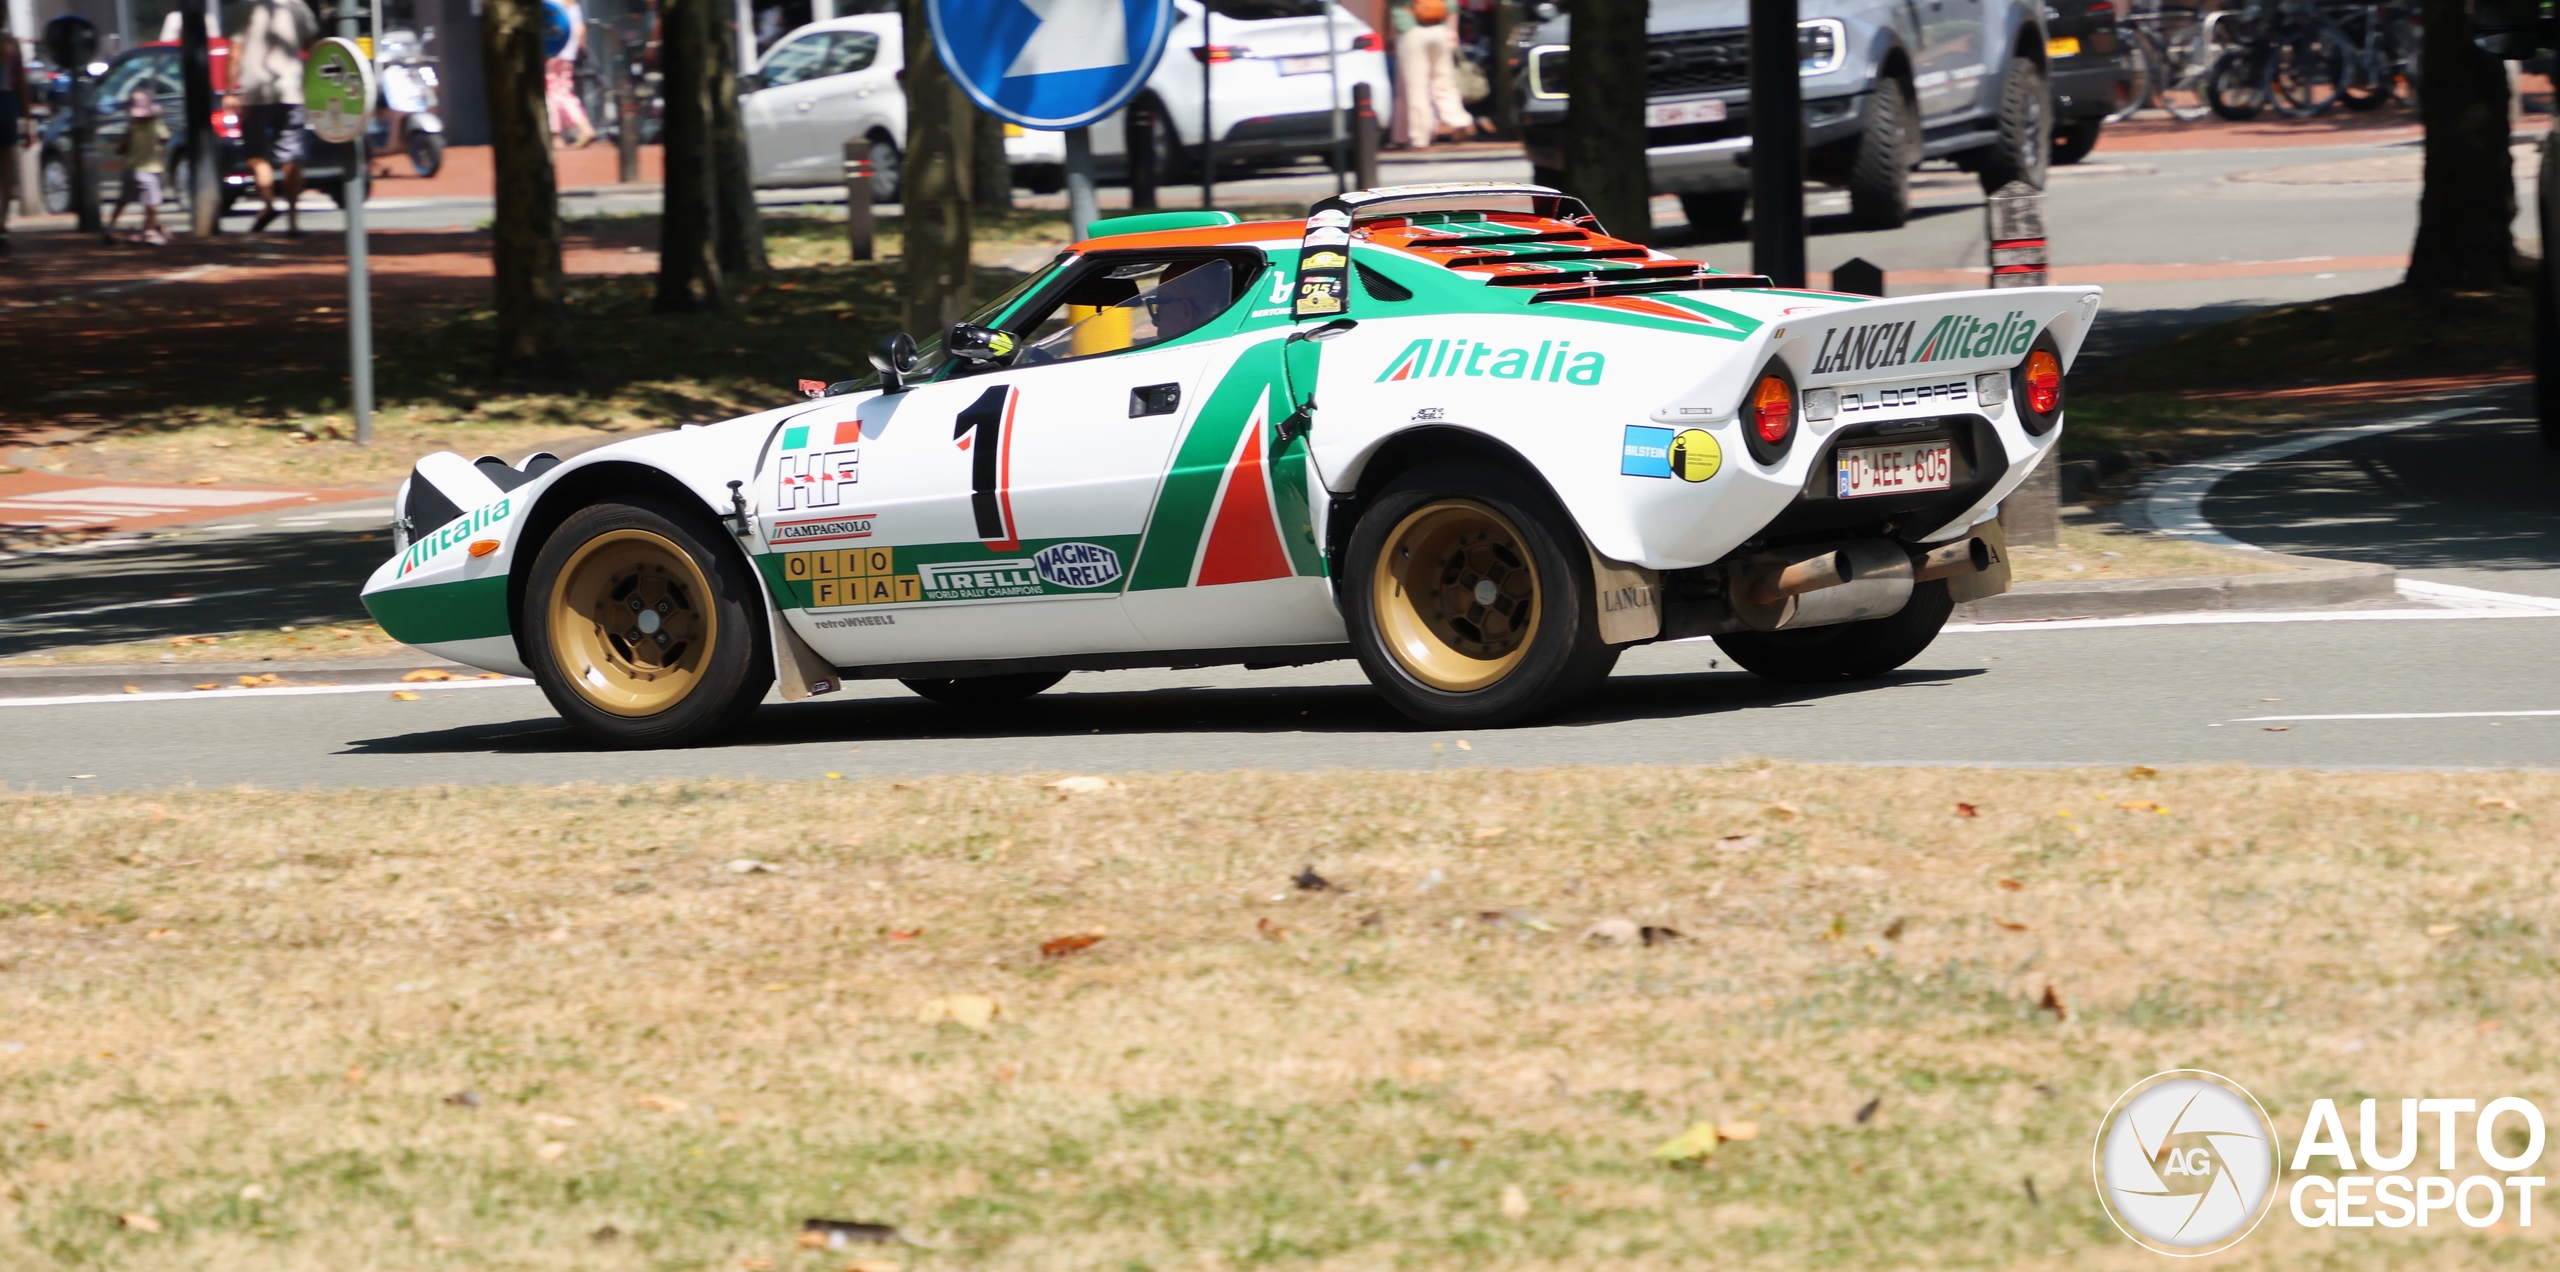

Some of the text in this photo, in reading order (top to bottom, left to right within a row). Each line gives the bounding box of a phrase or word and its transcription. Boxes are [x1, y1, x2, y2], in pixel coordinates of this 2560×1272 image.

[1301, 283, 1330, 295] 015
[1251, 307, 1293, 318] BERTONE
[1811, 311, 2036, 374] LANCIA Alitalia
[1374, 339, 1606, 386] Alitalia
[1841, 382, 1968, 412] OLDCARS
[1624, 445, 1666, 459] BILSTEIN
[953, 384, 1016, 545] 1
[777, 448, 859, 511] HF
[1840, 477, 1849, 493] B
[397, 499, 510, 580] Alitalia
[784, 520, 871, 538] CAMPAGNOLO
[790, 552, 887, 576] OLIO
[1037, 544, 1117, 568] MAGNETI
[917, 558, 1040, 590] PIRELLI
[1040, 564, 1119, 585] MARELLI
[820, 579, 914, 602] FIAT
[926, 586, 1044, 599] WORLD RALLY CHAMPIONS
[814, 615, 896, 629] retroWHEELZ
